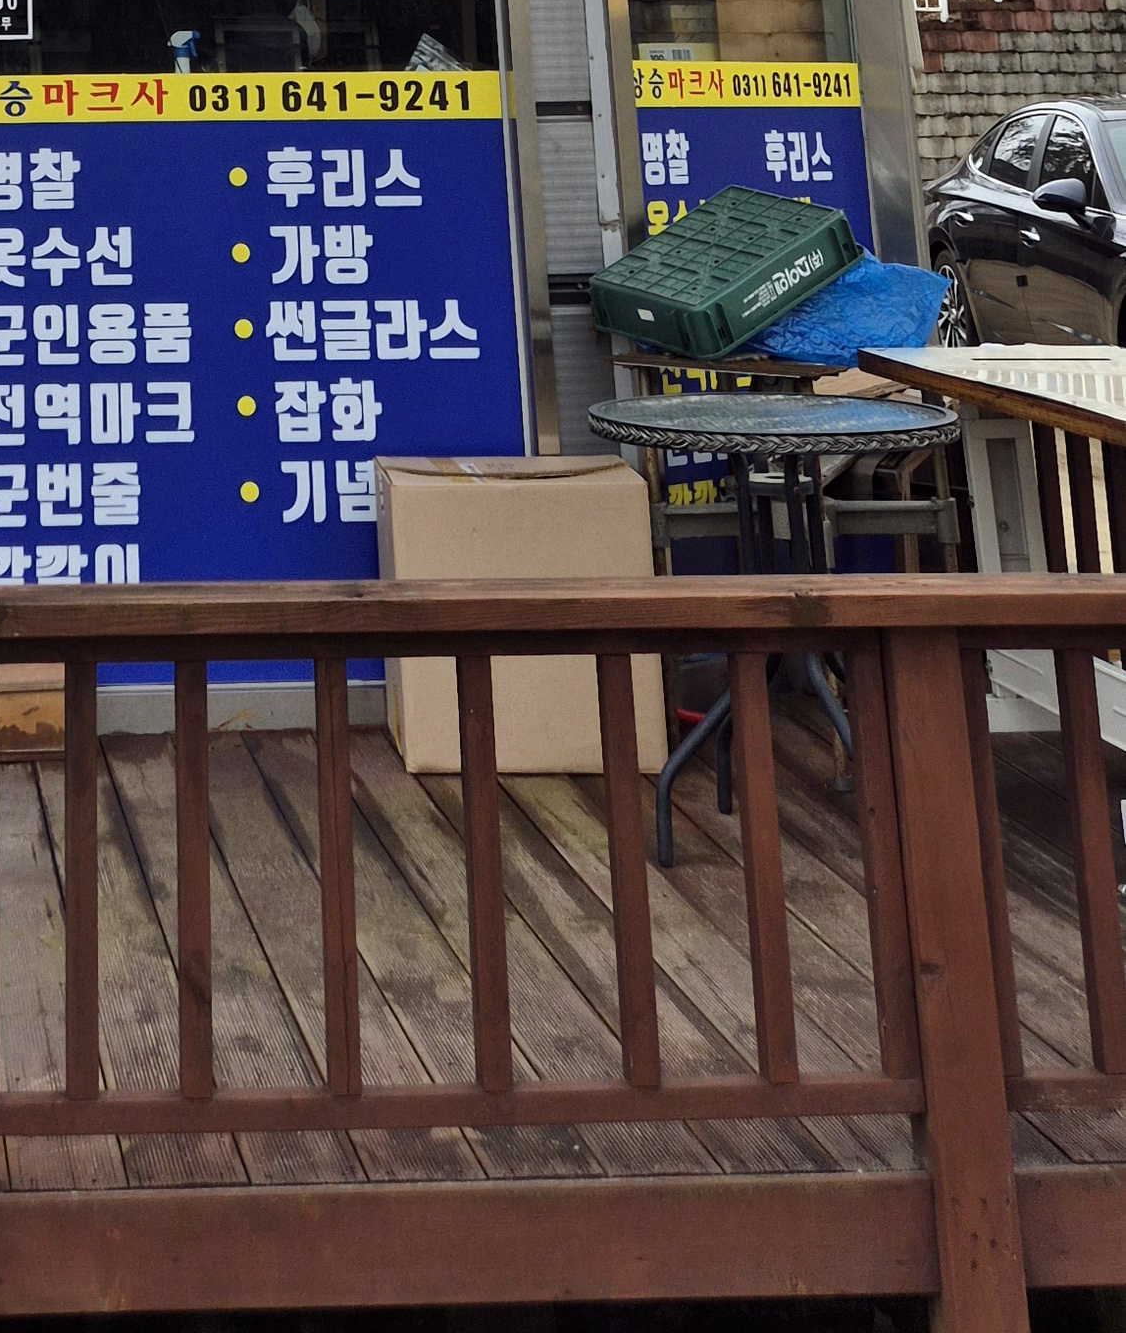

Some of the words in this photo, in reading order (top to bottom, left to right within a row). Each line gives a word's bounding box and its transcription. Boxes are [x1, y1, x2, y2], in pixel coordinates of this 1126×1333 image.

[188, 84, 266, 113] 031)
[281, 79, 471, 113] 641-9241
[732, 73, 766, 98] 031)
[772, 71, 852, 98] 641-9241
[265, 146, 424, 209] 후리스
[641, 129, 690, 186] 명찰
[764, 129, 834, 183] 후리스
[269, 224, 373, 285] 가방
[265, 298, 480, 362] 썬글라스
[274, 377, 382, 443] 잡화
